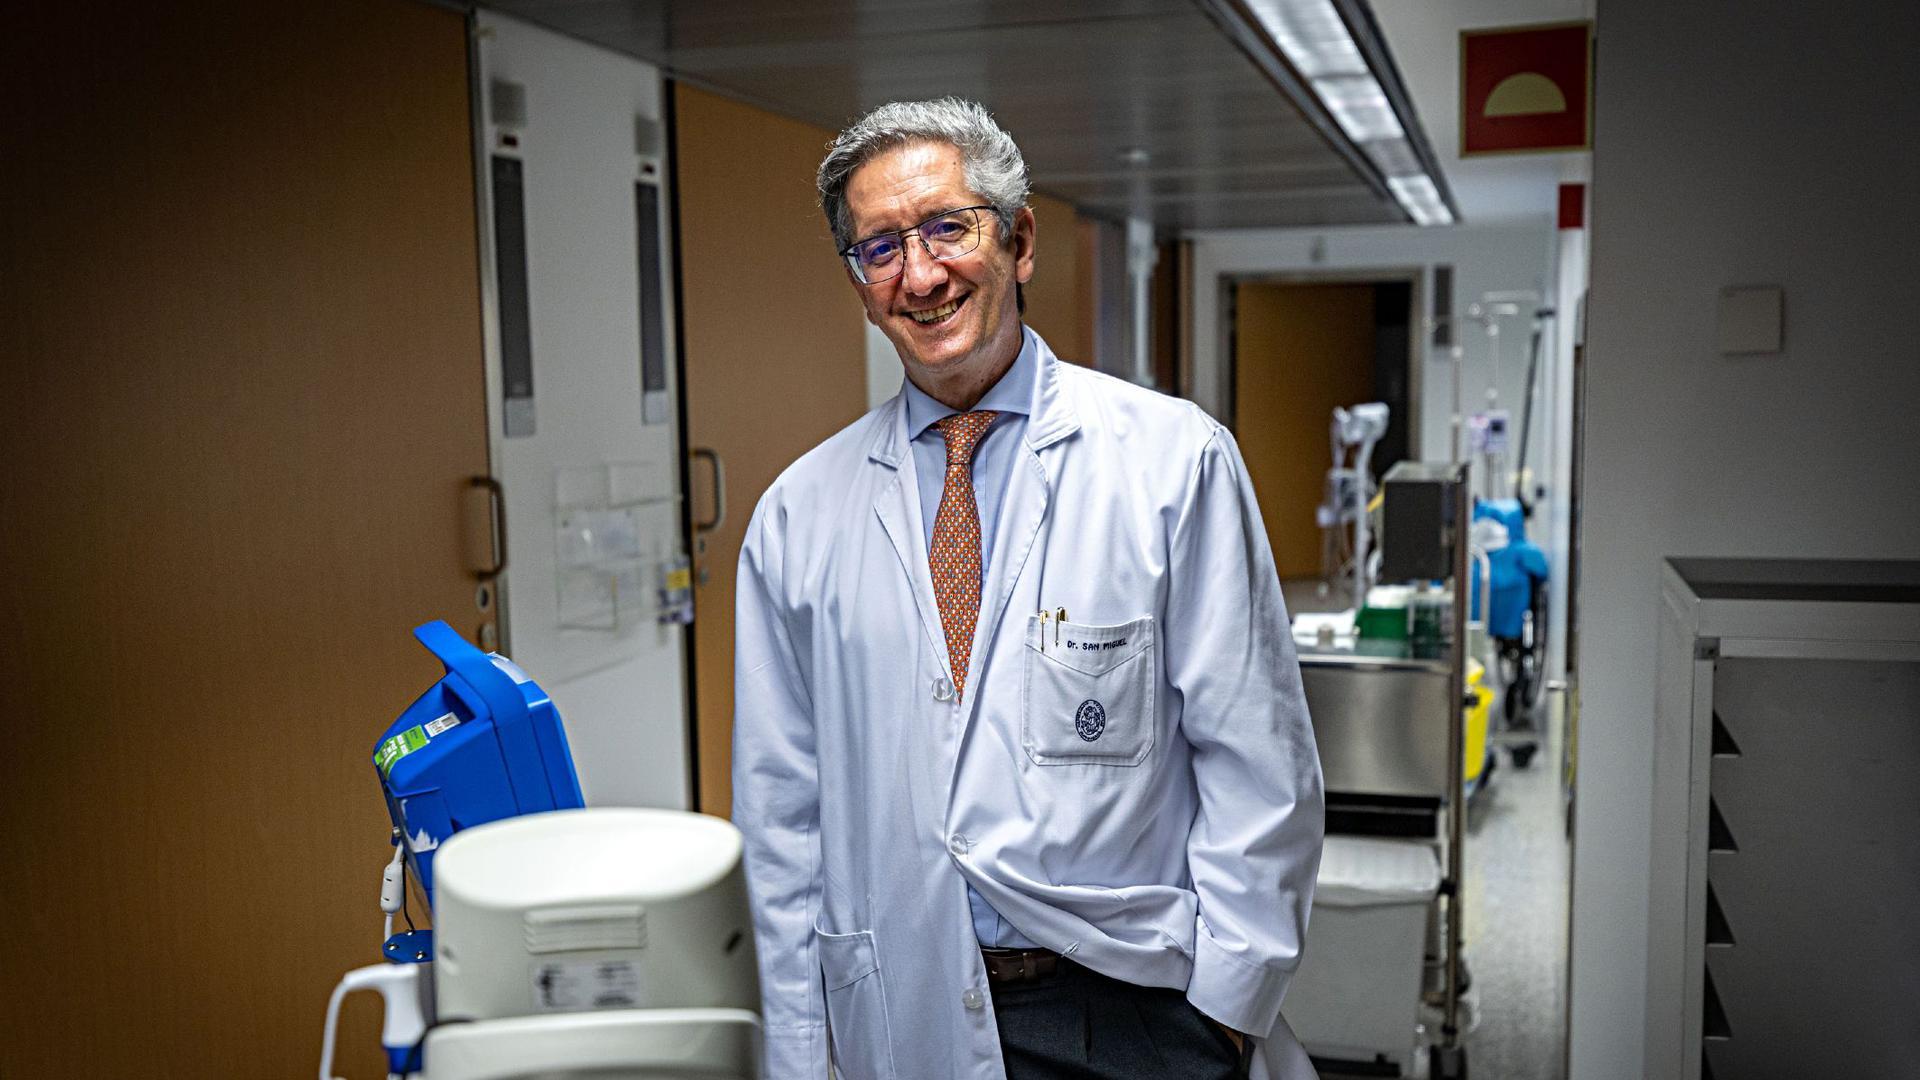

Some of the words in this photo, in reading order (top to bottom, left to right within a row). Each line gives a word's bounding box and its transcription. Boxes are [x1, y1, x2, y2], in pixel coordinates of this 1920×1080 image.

[1067, 640, 1078, 649] Dr.
[1082, 642, 1099, 650] SAN
[1103, 637, 1127, 650] MIGUEL
